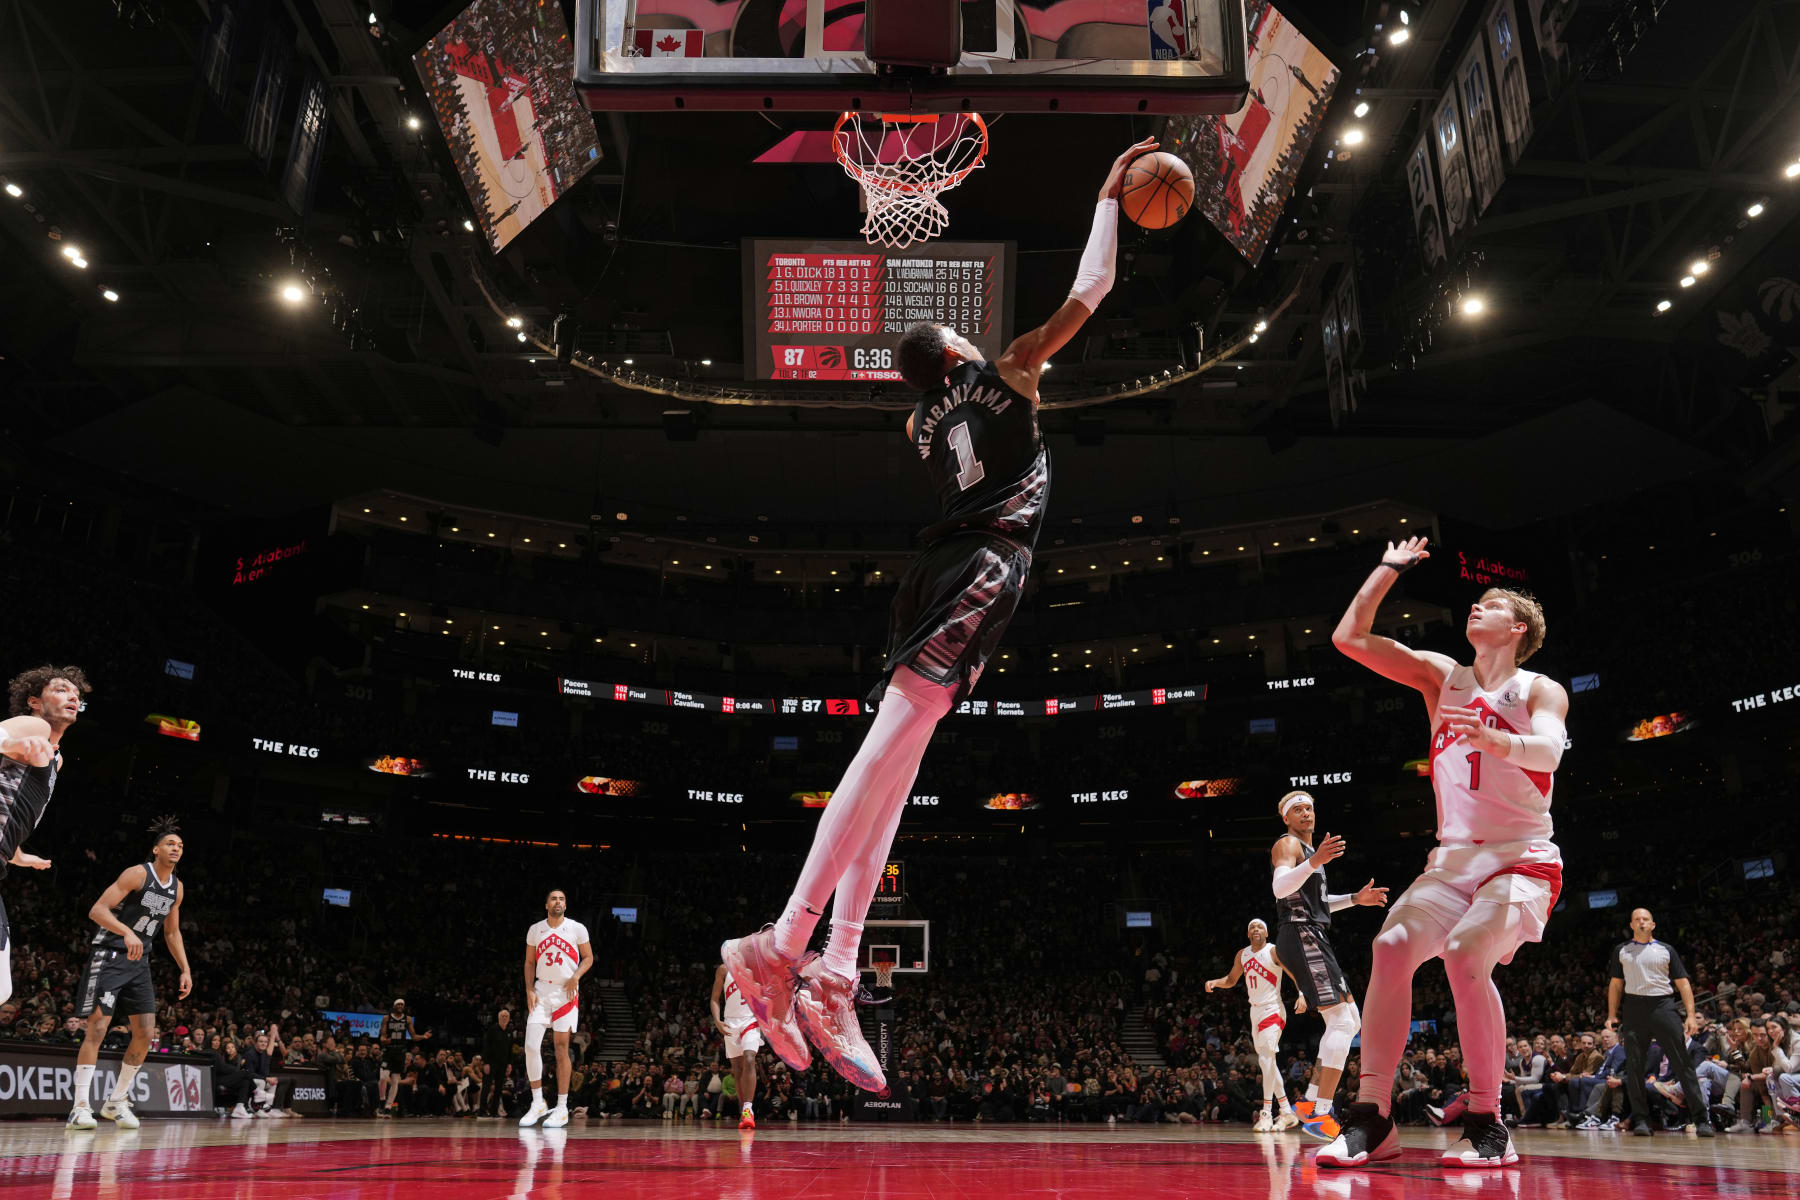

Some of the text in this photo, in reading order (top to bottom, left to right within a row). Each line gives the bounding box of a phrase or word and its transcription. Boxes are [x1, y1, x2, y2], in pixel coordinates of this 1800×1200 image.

[1155, 48, 1173, 59] NBA
[775, 258, 805, 266] TORONTO
[887, 259, 900, 267] SAN
[902, 259, 933, 267] ANTONIO
[776, 267, 869, 278] 1 G. DICK 18 1 0 1
[888, 269, 982, 280] 1 25 14 5 2
[775, 280, 782, 291] 5
[791, 281, 821, 292] QUICKLEY
[826, 281, 833, 292] 7
[838, 281, 845, 292] 3
[850, 281, 858, 292] 3
[863, 281, 870, 292] 2
[885, 282, 895, 292] 10
[904, 282, 933, 292] SOCHAN
[936, 283, 946, 293] 16
[950, 283, 957, 293] 6
[962, 283, 970, 293] 0
[975, 283, 981, 293] 2
[774, 294, 784, 304] 11
[794, 294, 822, 304] BROWN
[826, 295, 833, 305] 7
[838, 295, 845, 305] 4
[850, 295, 858, 305] 4
[864, 295, 869, 305] 1
[885, 295, 895, 306] 14
[905, 295, 933, 306] WESLEY
[937, 296, 944, 307] 8
[949, 296, 957, 307] 0
[962, 296, 969, 307] 2
[974, 296, 981, 307] 0
[774, 307, 784, 318] 13
[826, 308, 833, 318] 0
[839, 308, 844, 318] 1
[850, 308, 858, 318] 0
[863, 308, 870, 318] 0
[885, 308, 895, 319] 16
[905, 308, 933, 319] OSMAN
[936, 309, 944, 320] 5
[949, 309, 956, 320] 3
[962, 309, 969, 320] 2
[974, 309, 981, 320] 2
[774, 321, 784, 331] 34
[792, 321, 822, 331] PORTER
[826, 321, 833, 332] 0
[838, 321, 845, 332] 0
[850, 321, 858, 332] 0
[863, 321, 870, 332] 0
[885, 322, 895, 332] 24
[962, 323, 968, 334] 5
[975, 323, 980, 334] 1
[784, 348, 804, 366] 87
[854, 348, 892, 369] 6:36
[868, 371, 903, 380] TISSO
[919, 383, 1012, 460] WEMBANYAMA
[947, 420, 985, 491] 1
[235, 539, 309, 571] Sotiaban
[1457, 549, 1528, 582] Sotiaban
[232, 567, 272, 585] Aen
[453, 668, 501, 682] THE KEG
[564, 679, 588, 689] Pacers
[1267, 677, 1315, 690] THE KEG
[564, 686, 591, 696] Hornets
[629, 690, 646, 698] Final
[674, 691, 692, 700] 76ers
[1183, 689, 1195, 697] 4th
[1103, 694, 1122, 702] 76ers
[1732, 694, 1767, 713] THE
[674, 700, 704, 709] Cavaliers
[802, 699, 822, 713] 87
[997, 701, 1020, 709] Pacers
[1060, 702, 1076, 710] Final
[1103, 700, 1135, 709] Cavaliers
[1435, 706, 1513, 749] RATO
[253, 737, 319, 759] THE KEG
[467, 768, 529, 784] THE KEG
[1466, 751, 1482, 791] 1
[1290, 772, 1352, 787] THE KEG
[688, 789, 743, 803] THE KEG
[913, 795, 939, 806] KEG
[1071, 790, 1128, 804] THE KEG
[883, 864, 899, 876] :36
[545, 952, 564, 966] 34
[1243, 961, 1268, 977] APTORS
[1249, 975, 1258, 989] 11
[880, 1021, 889, 1071] JACKPOTCITY
[0, 1064, 150, 1102] OKERTARS
[293, 1087, 326, 1101] ERSTARS
[864, 1101, 902, 1109] AEROPLAN
